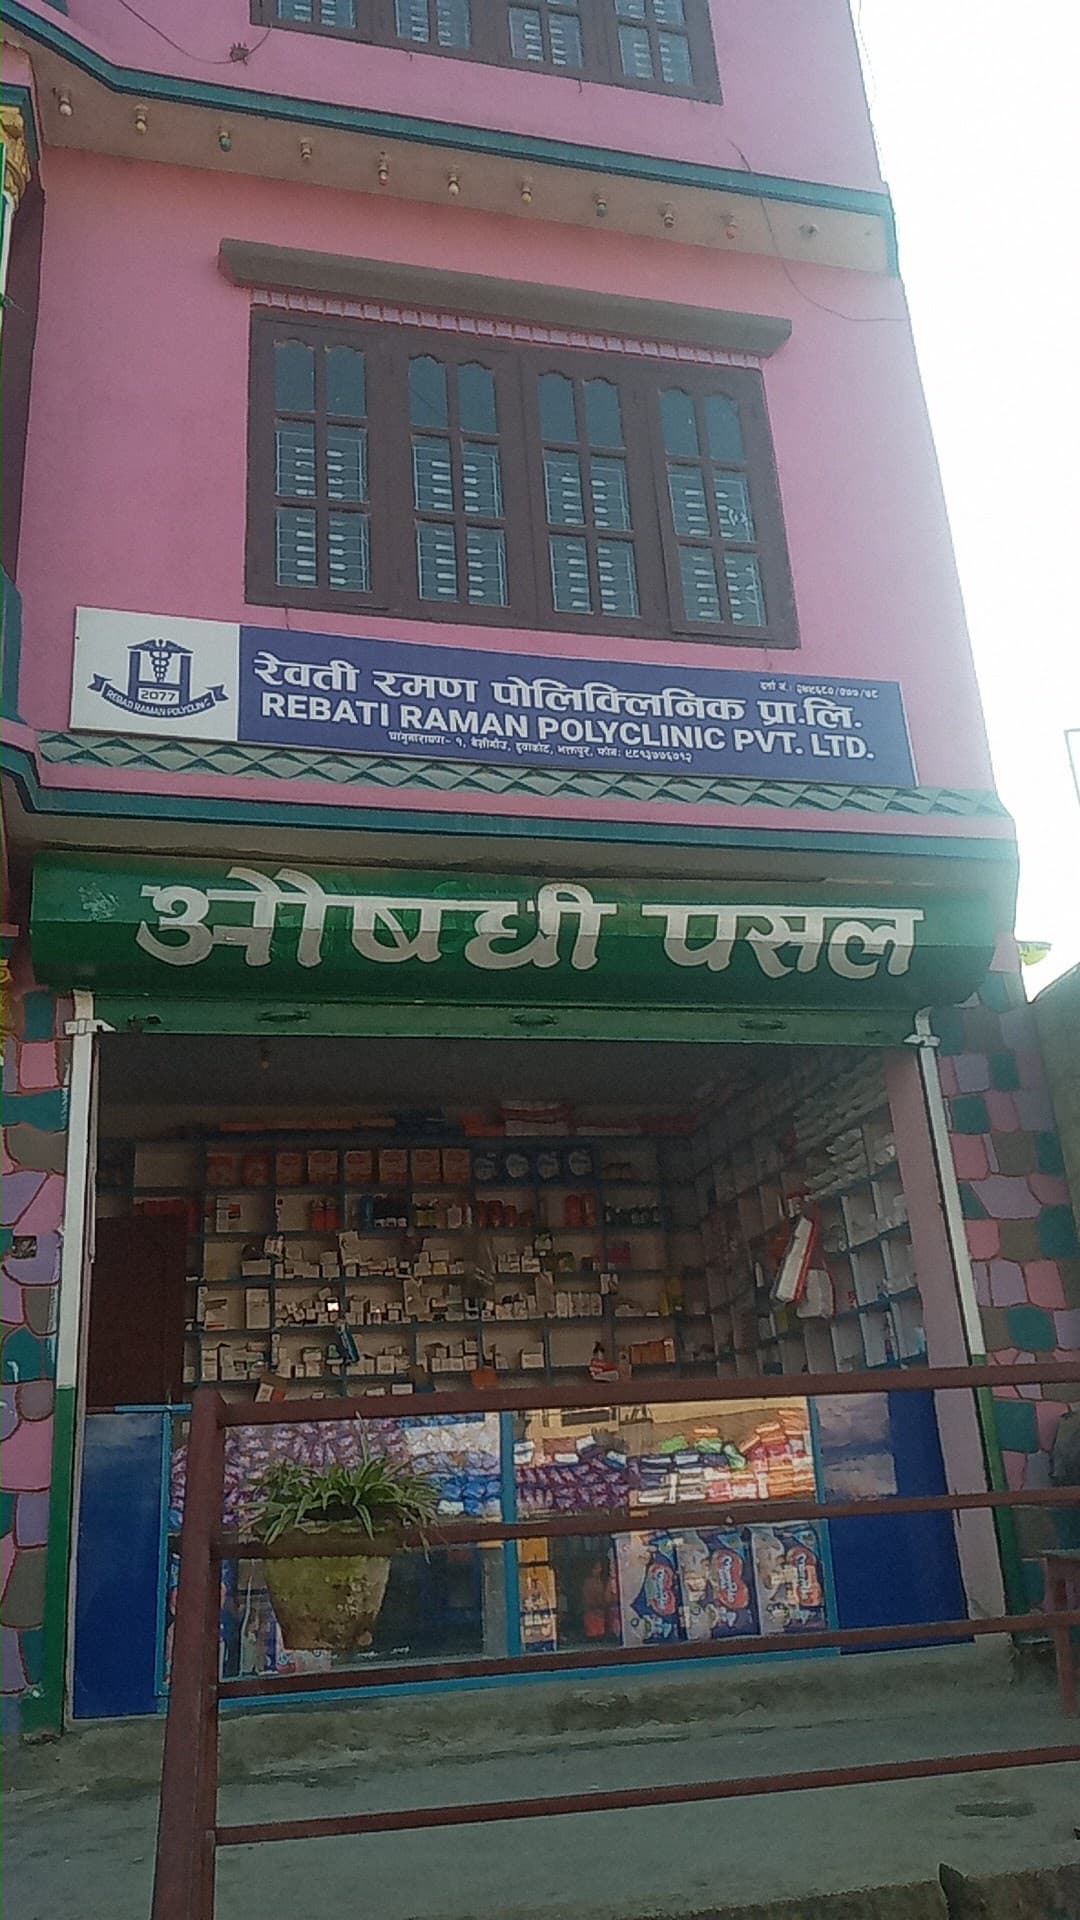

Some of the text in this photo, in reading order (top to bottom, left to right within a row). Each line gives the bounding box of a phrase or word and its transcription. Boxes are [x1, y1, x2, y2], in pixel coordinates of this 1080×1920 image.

[141, 689, 176, 701] 2077
[253, 651, 361, 693] रेवती
[372, 669, 478, 703] रमण
[492, 676, 747, 721] पोलिक्लिनिक
[261, 692, 875, 760] REBATI RAMAN POLYCLINIC PVT. LTD.
[643, 901, 925, 982] पसल
